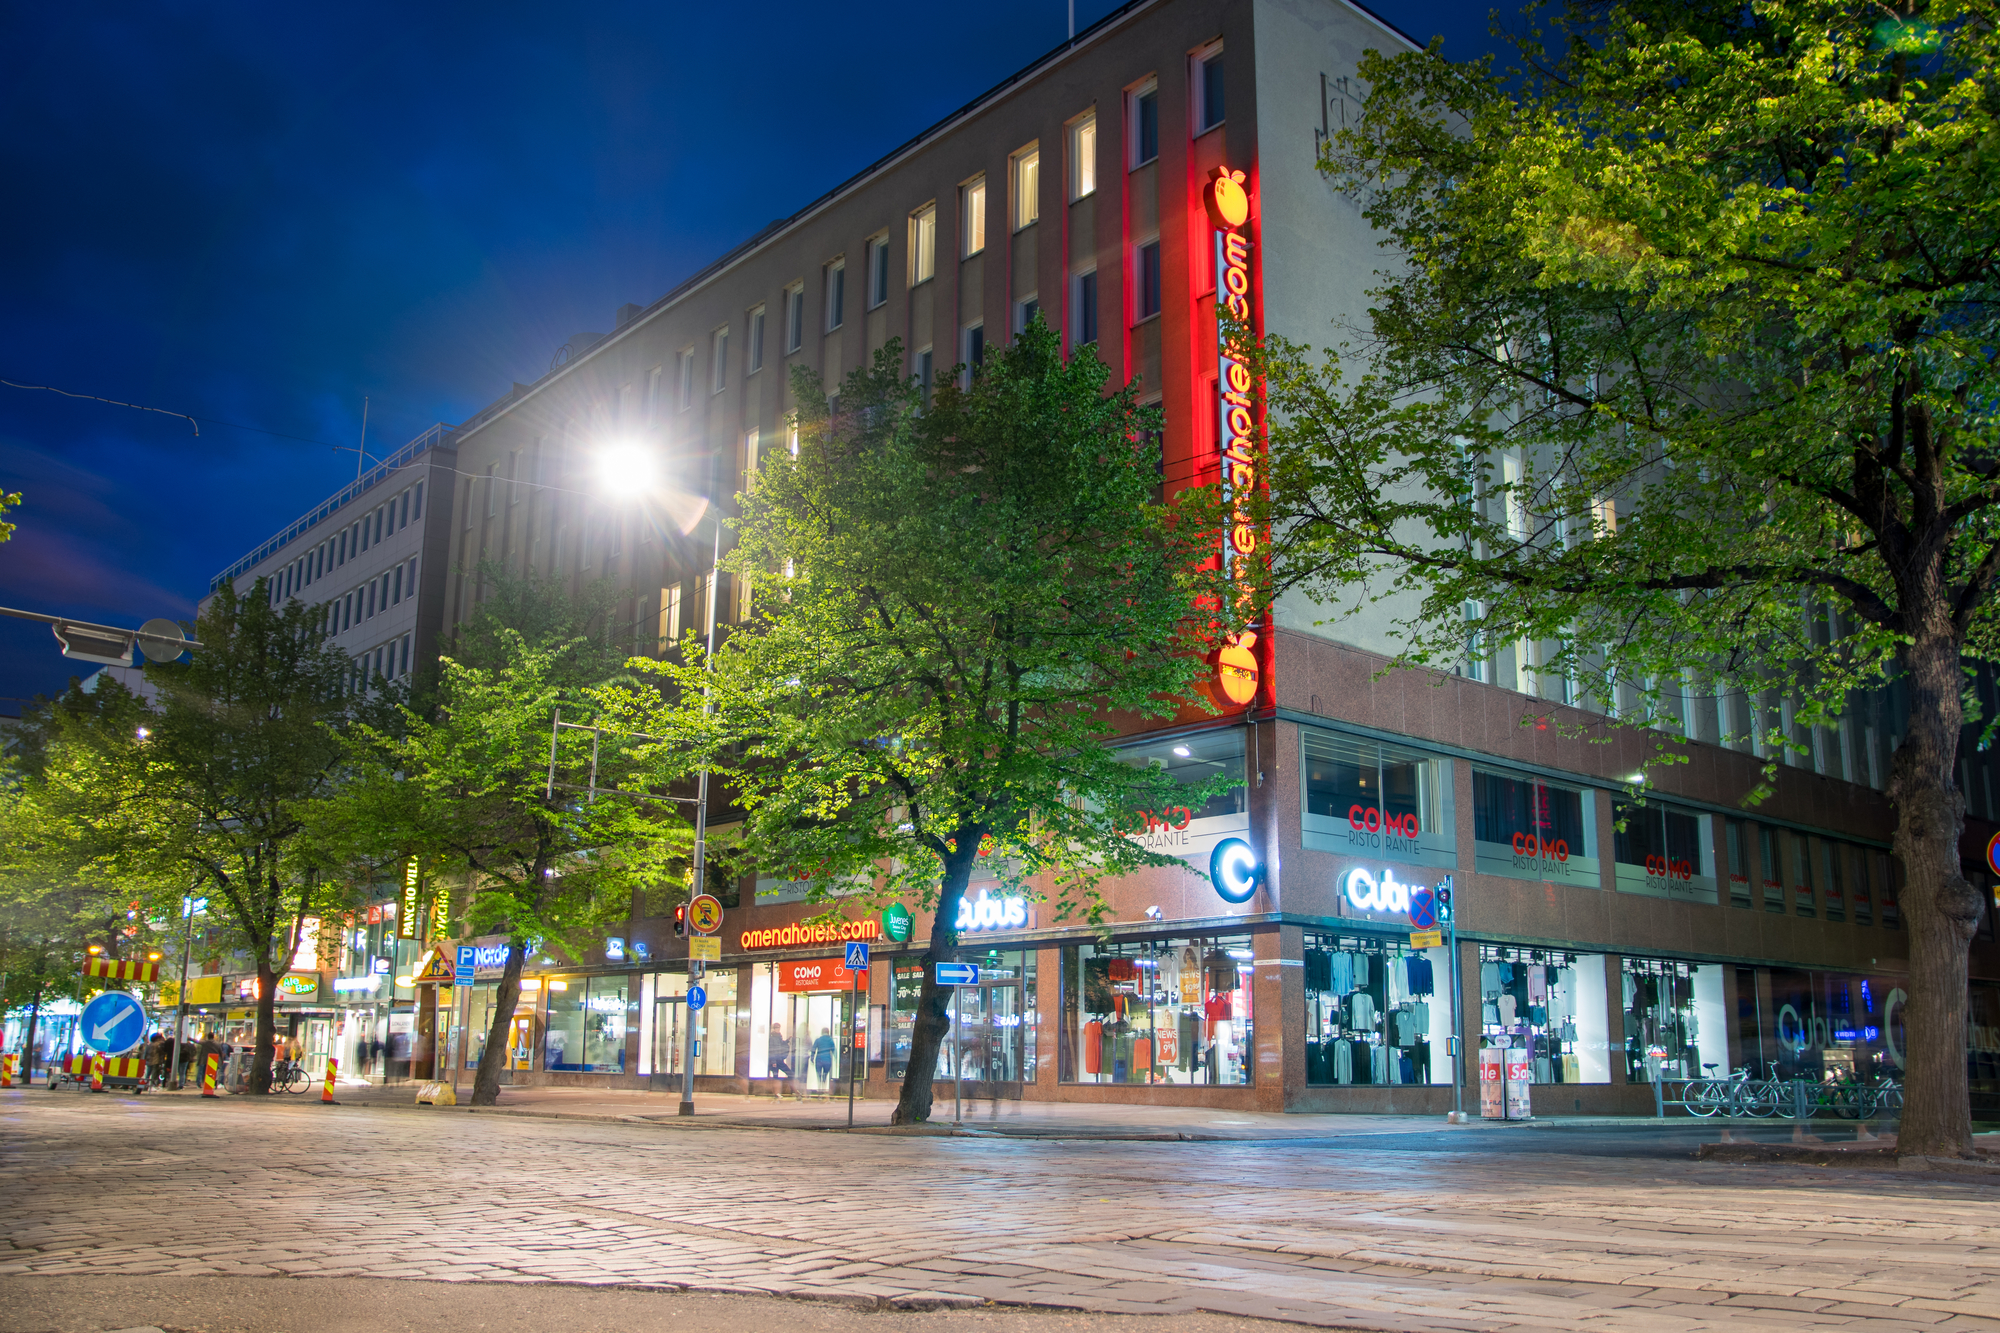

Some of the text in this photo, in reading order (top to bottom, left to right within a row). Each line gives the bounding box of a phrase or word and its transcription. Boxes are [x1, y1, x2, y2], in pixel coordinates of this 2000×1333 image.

[1348, 804, 1419, 839] COMO
[1348, 830, 1421, 855] RISTORANTE
[1512, 831, 1569, 862] COMO
[1220, 843, 1257, 896] C
[1512, 855, 1571, 877] RISTORANTE
[1646, 854, 1692, 881] COMO
[1347, 868, 1426, 913] Cubu
[1646, 875, 1694, 895] RISTORANTE
[461, 948, 473, 964] P
[475, 943, 510, 966] Norde
[794, 965, 821, 979] COMO
[1180, 970, 1200, 979] NEWS
[283, 978, 299, 987] Ale
[295, 984, 315, 994] Bar
[911, 988, 921, 998] -70
[1157, 1030, 1177, 1039] NEWS
[1480, 1063, 1496, 1079] ale
[1511, 1065, 1528, 1079] Sa
